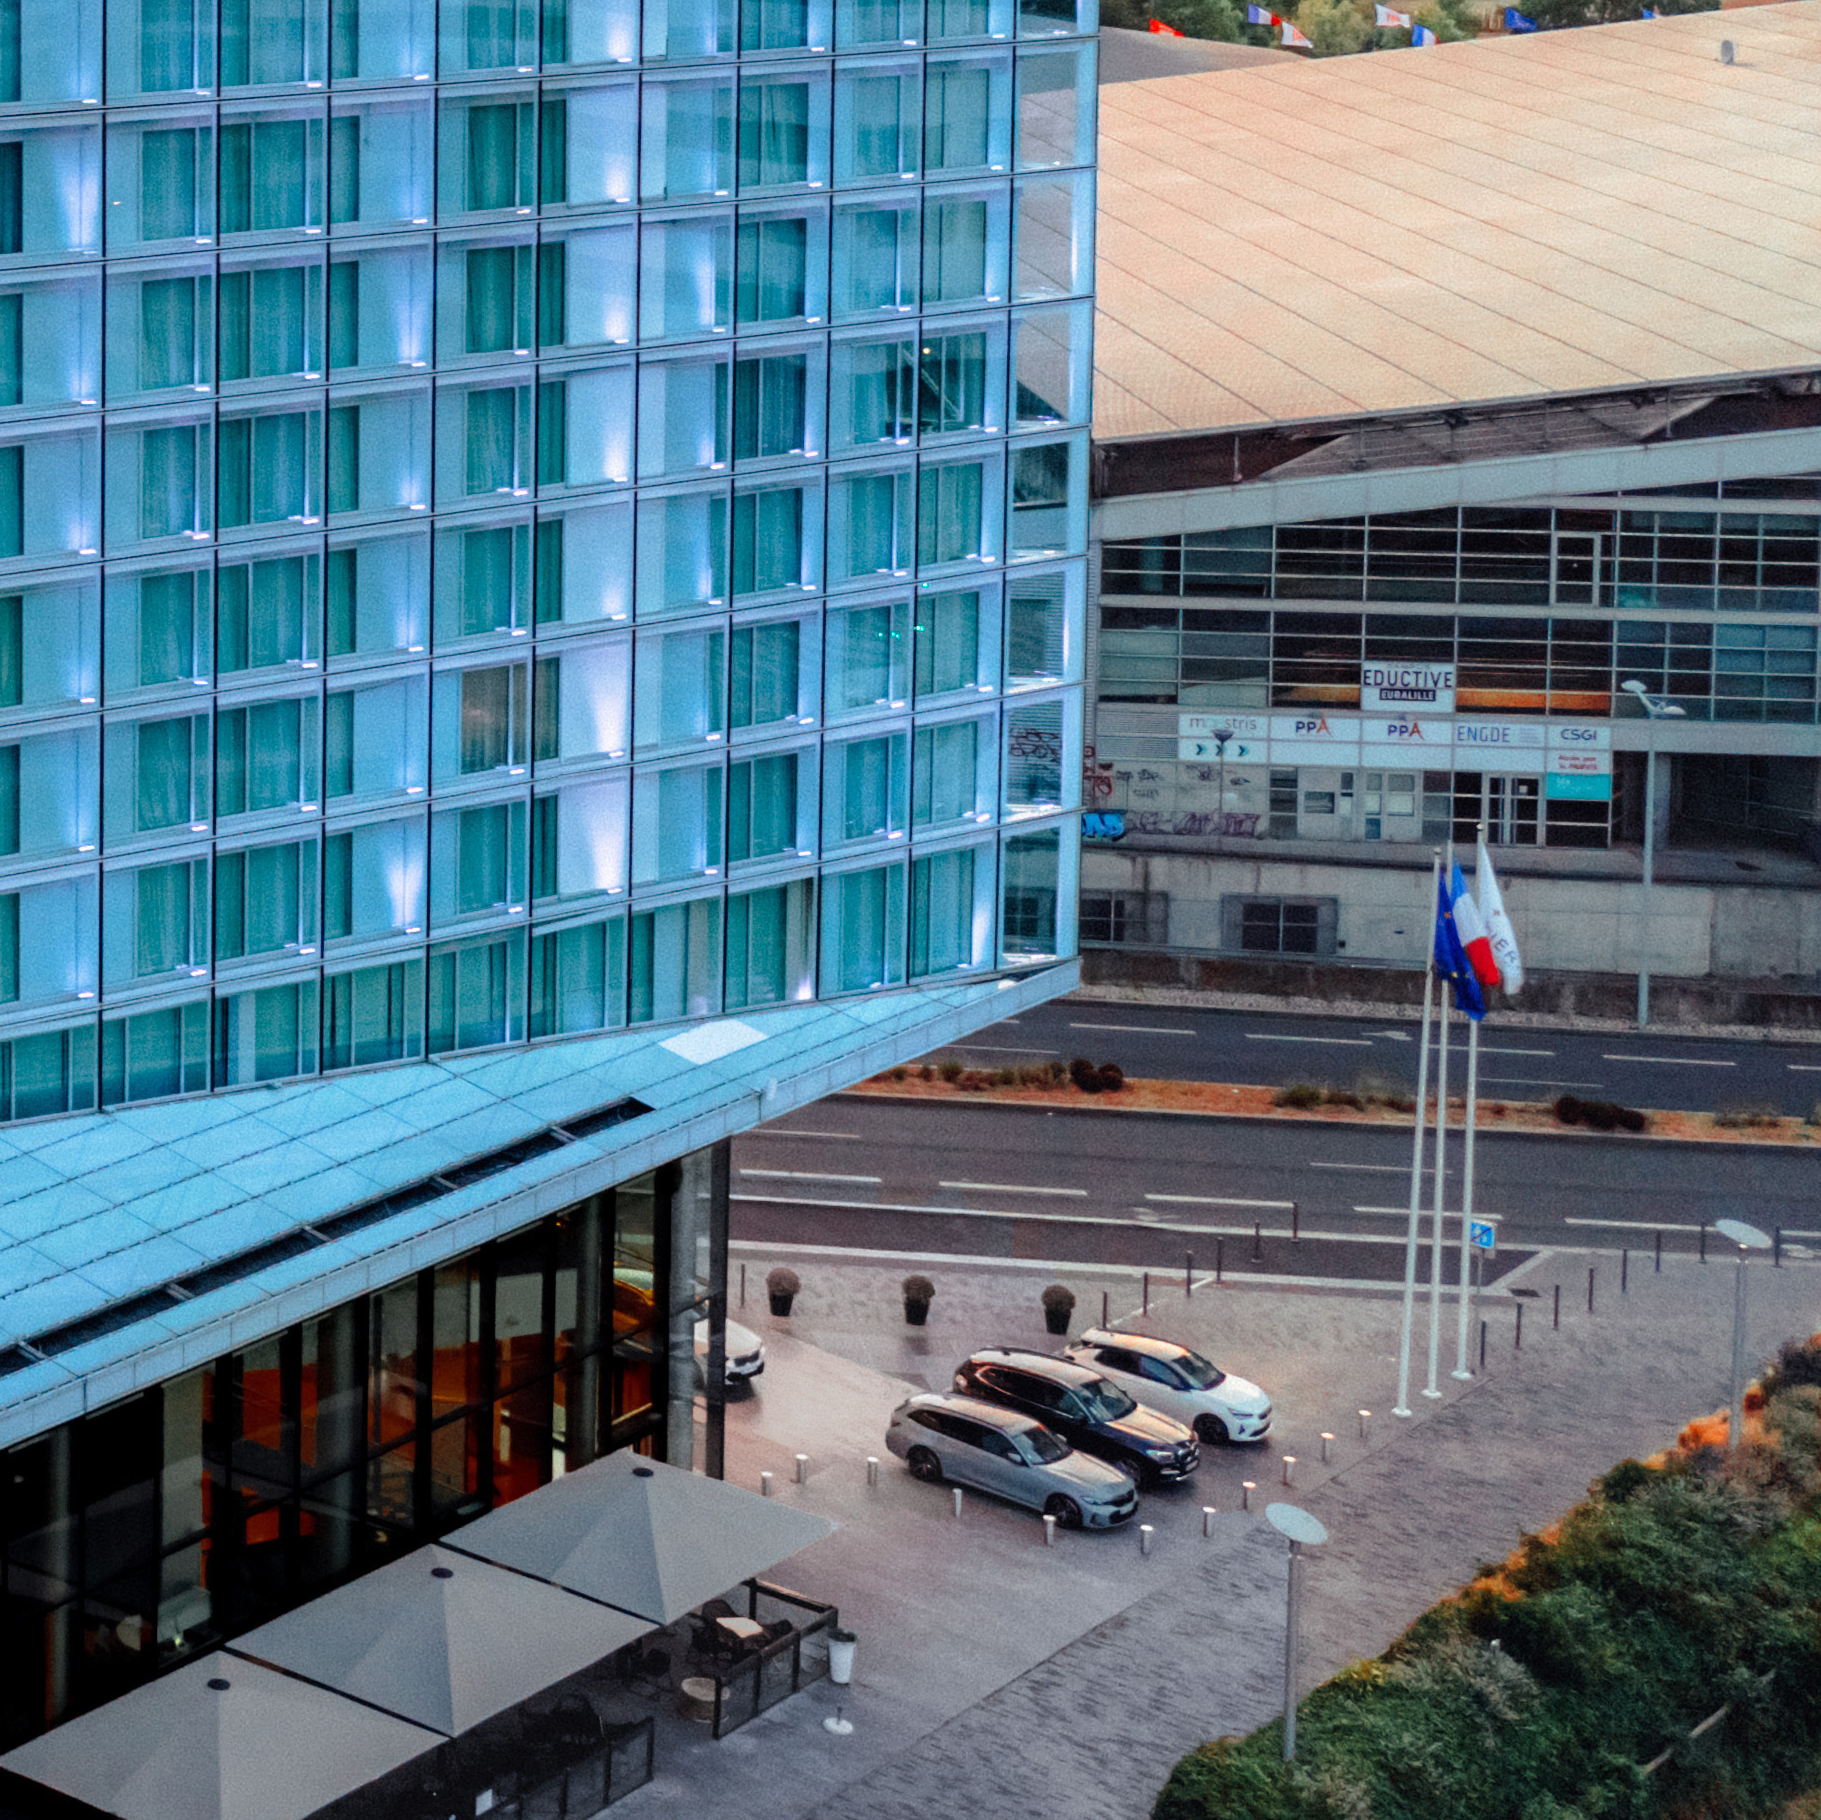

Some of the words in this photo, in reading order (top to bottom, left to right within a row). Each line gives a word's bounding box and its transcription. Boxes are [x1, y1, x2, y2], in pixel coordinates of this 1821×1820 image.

[1363, 669, 1453, 688] EDUCTIVE
[1294, 715, 1332, 736] PPA
[1386, 721, 1424, 740] PPA
[1457, 725, 1511, 743] ENGDE
